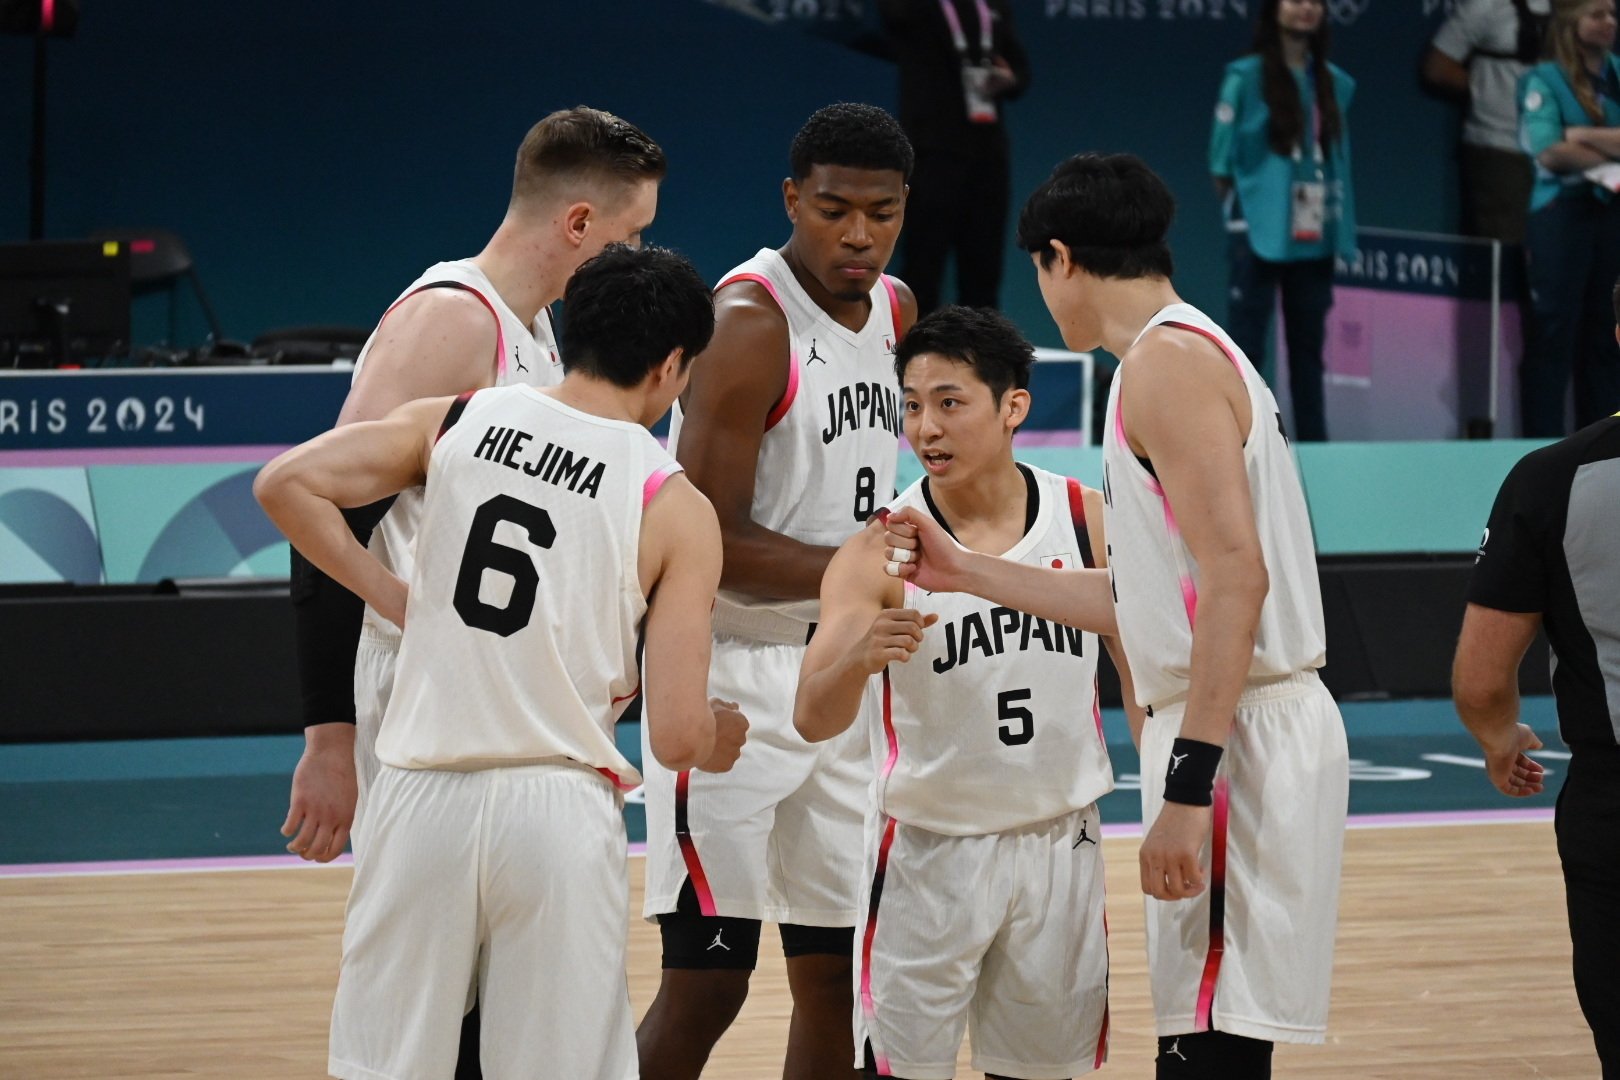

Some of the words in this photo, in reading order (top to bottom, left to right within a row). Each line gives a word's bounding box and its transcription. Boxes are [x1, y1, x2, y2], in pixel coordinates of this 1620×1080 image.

[1334, 249, 1388, 280] ARIS
[1396, 251, 1459, 286] 2024
[87, 396, 204, 433] 2024
[822, 382, 898, 445] JAPAN
[474, 426, 607, 499] HIEJIMA
[853, 466, 876, 523] 8
[453, 493, 557, 638] 6
[932, 606, 1083, 674] JAPAN
[997, 687, 1034, 747] 5
